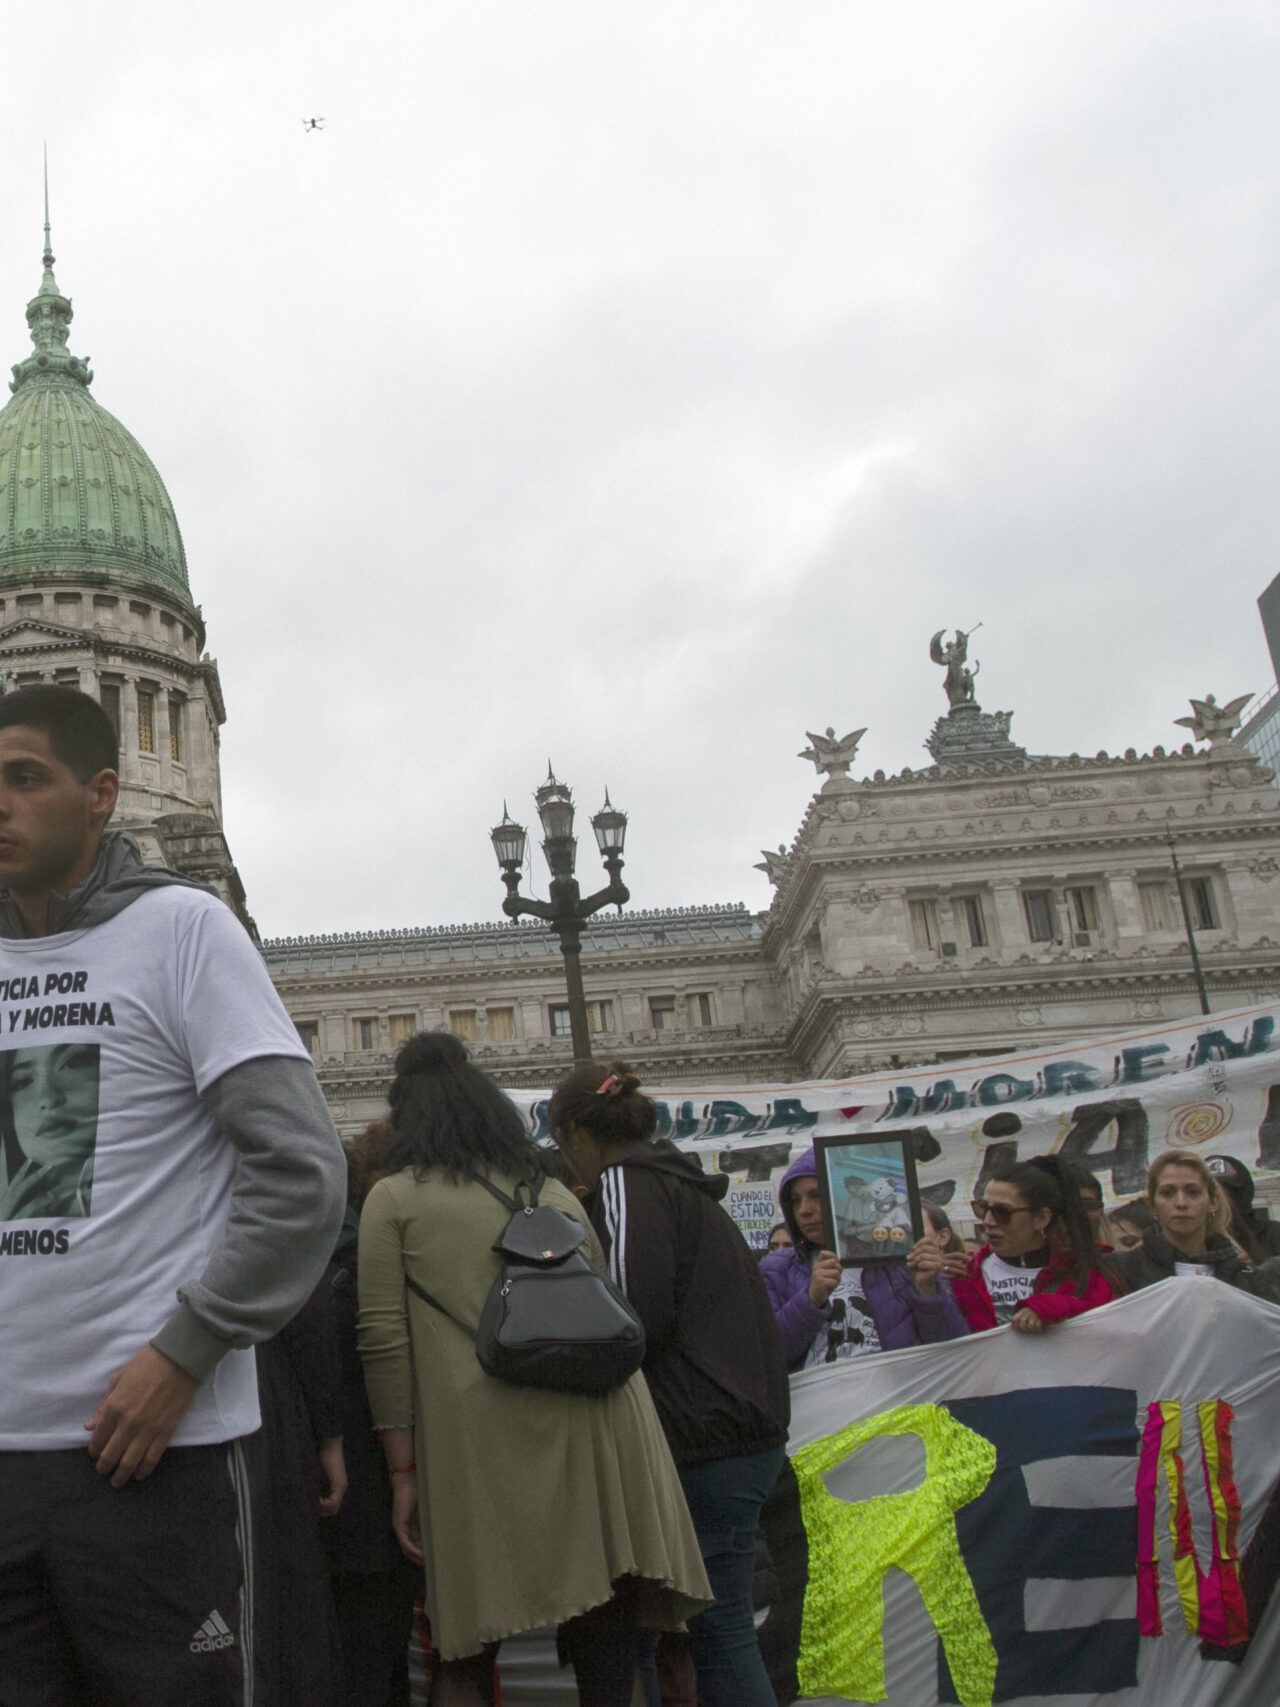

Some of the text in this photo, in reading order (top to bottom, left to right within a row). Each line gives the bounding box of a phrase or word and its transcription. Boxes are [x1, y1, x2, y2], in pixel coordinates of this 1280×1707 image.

[44, 971, 88, 996] POR
[9, 1010, 21, 1033] Y
[22, 1002, 116, 1031] MORENA
[730, 1190, 773, 1203] CUANDO EL
[731, 1202, 775, 1219] ESTADO
